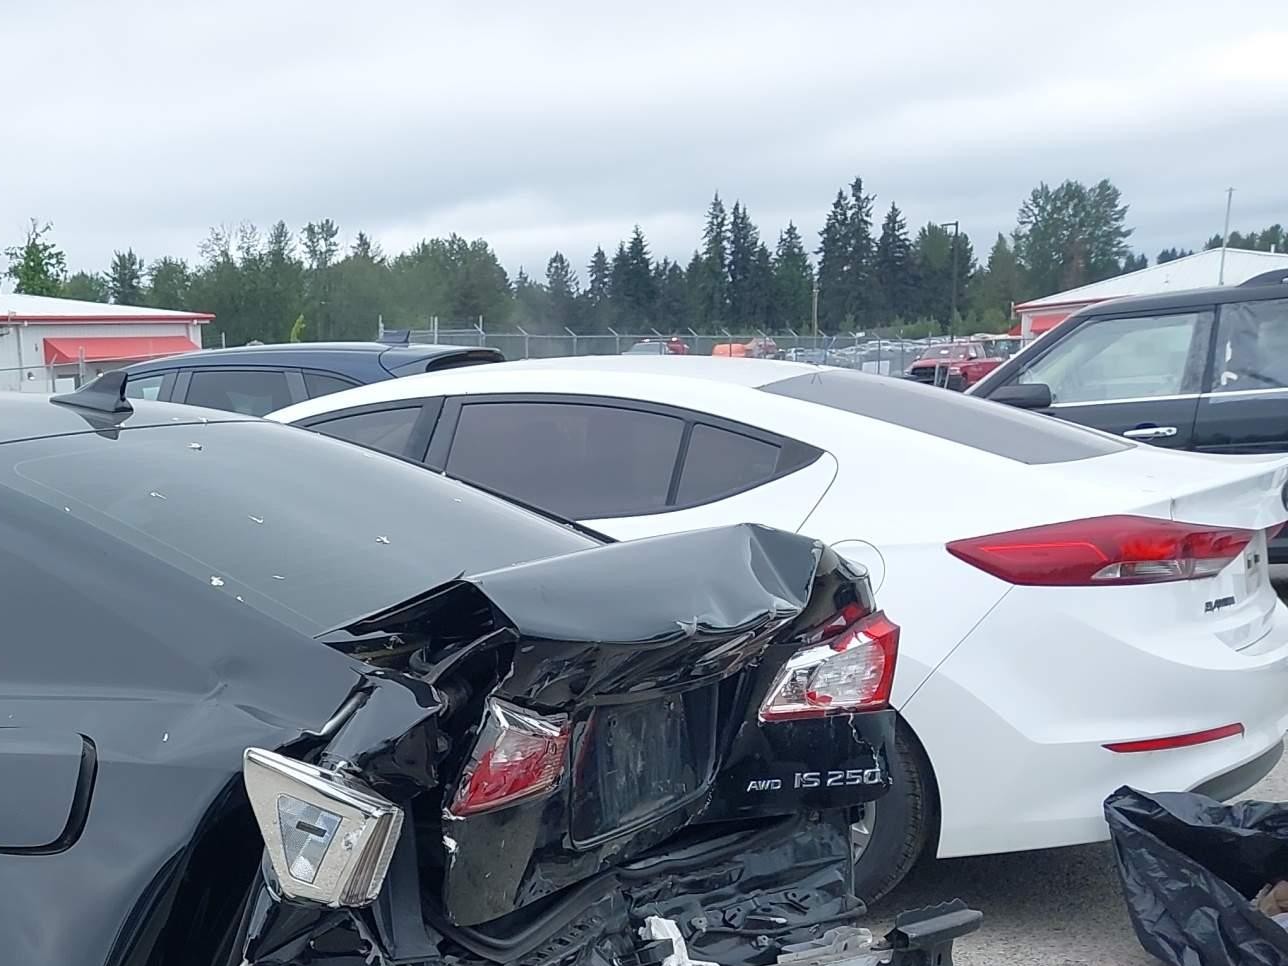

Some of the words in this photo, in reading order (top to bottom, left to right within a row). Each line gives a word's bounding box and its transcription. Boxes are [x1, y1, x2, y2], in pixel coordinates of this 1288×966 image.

[746, 779, 782, 793] AWD
[794, 772, 821, 789] IS
[826, 768, 881, 787] 250
